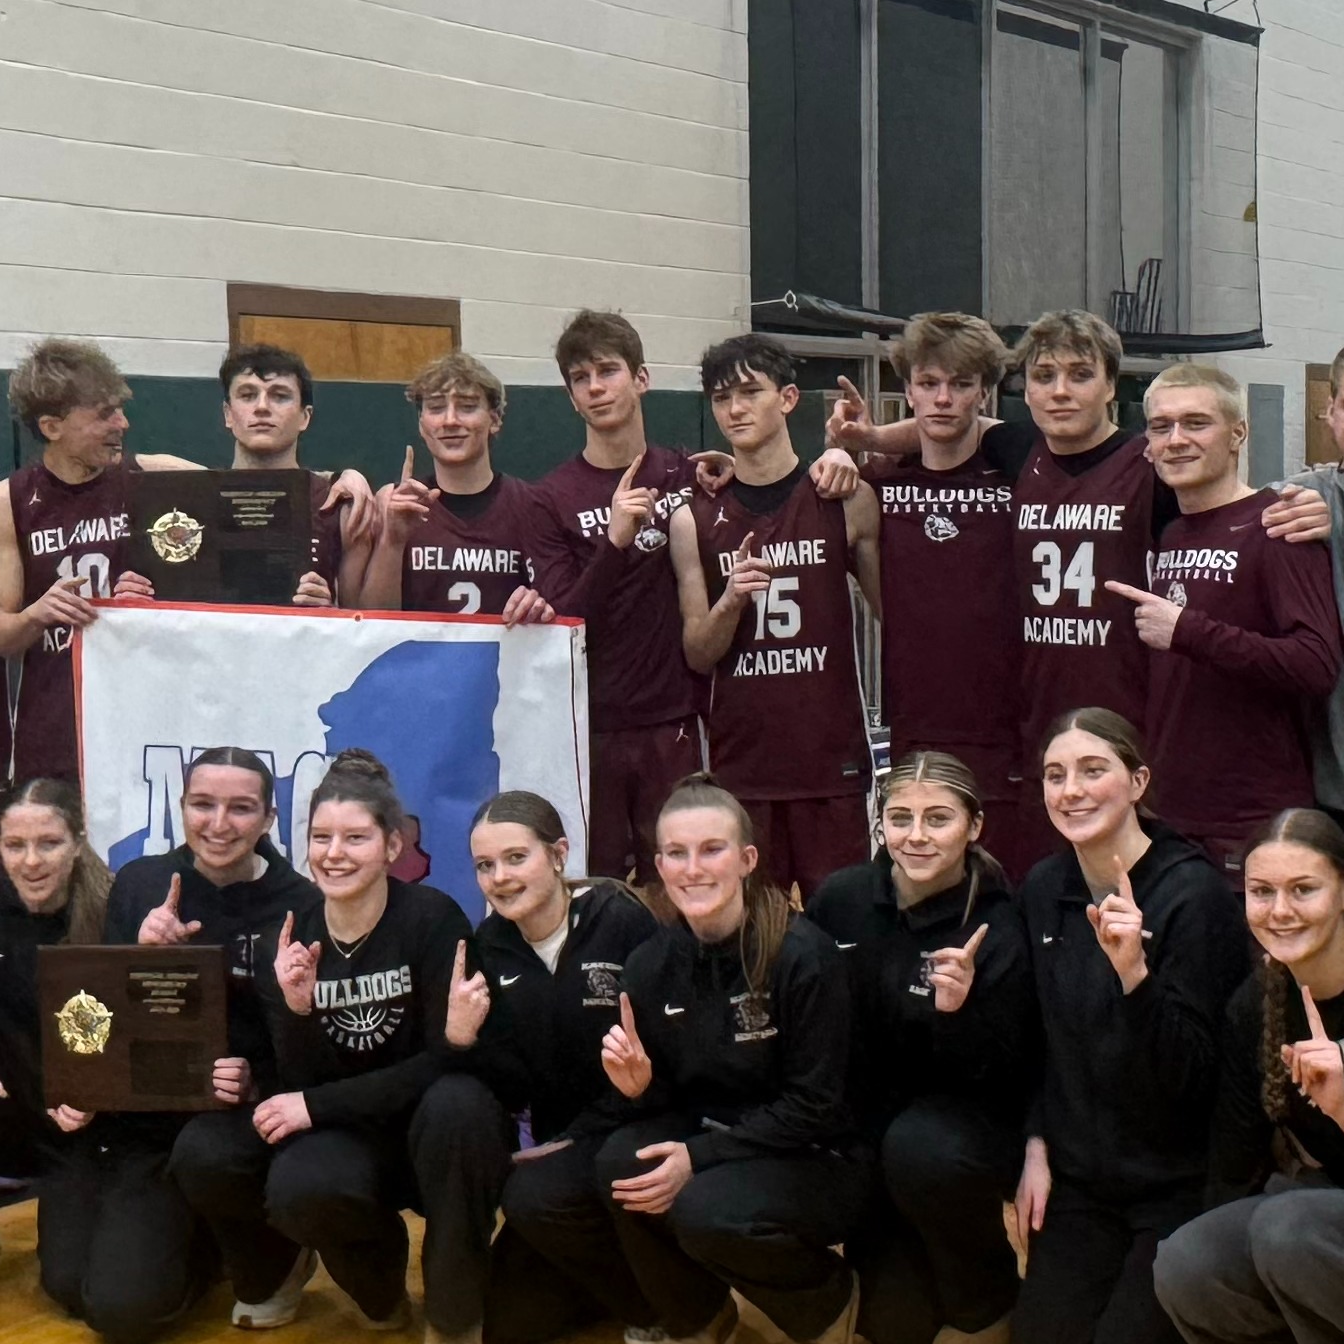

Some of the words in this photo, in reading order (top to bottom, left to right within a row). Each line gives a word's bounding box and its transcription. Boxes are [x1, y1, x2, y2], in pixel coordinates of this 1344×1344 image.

[882, 486, 1012, 503] BULLDOGS
[1018, 504, 1125, 530] DELAWARE
[30, 513, 131, 556] DELAWARE
[412, 547, 521, 573] DELAWARE
[1032, 541, 1095, 607] 34
[751, 576, 802, 640] 15
[1024, 618, 1112, 646] ACADEMY
[733, 646, 827, 677] ACADEMY
[314, 965, 412, 1009] ULLDOGS
